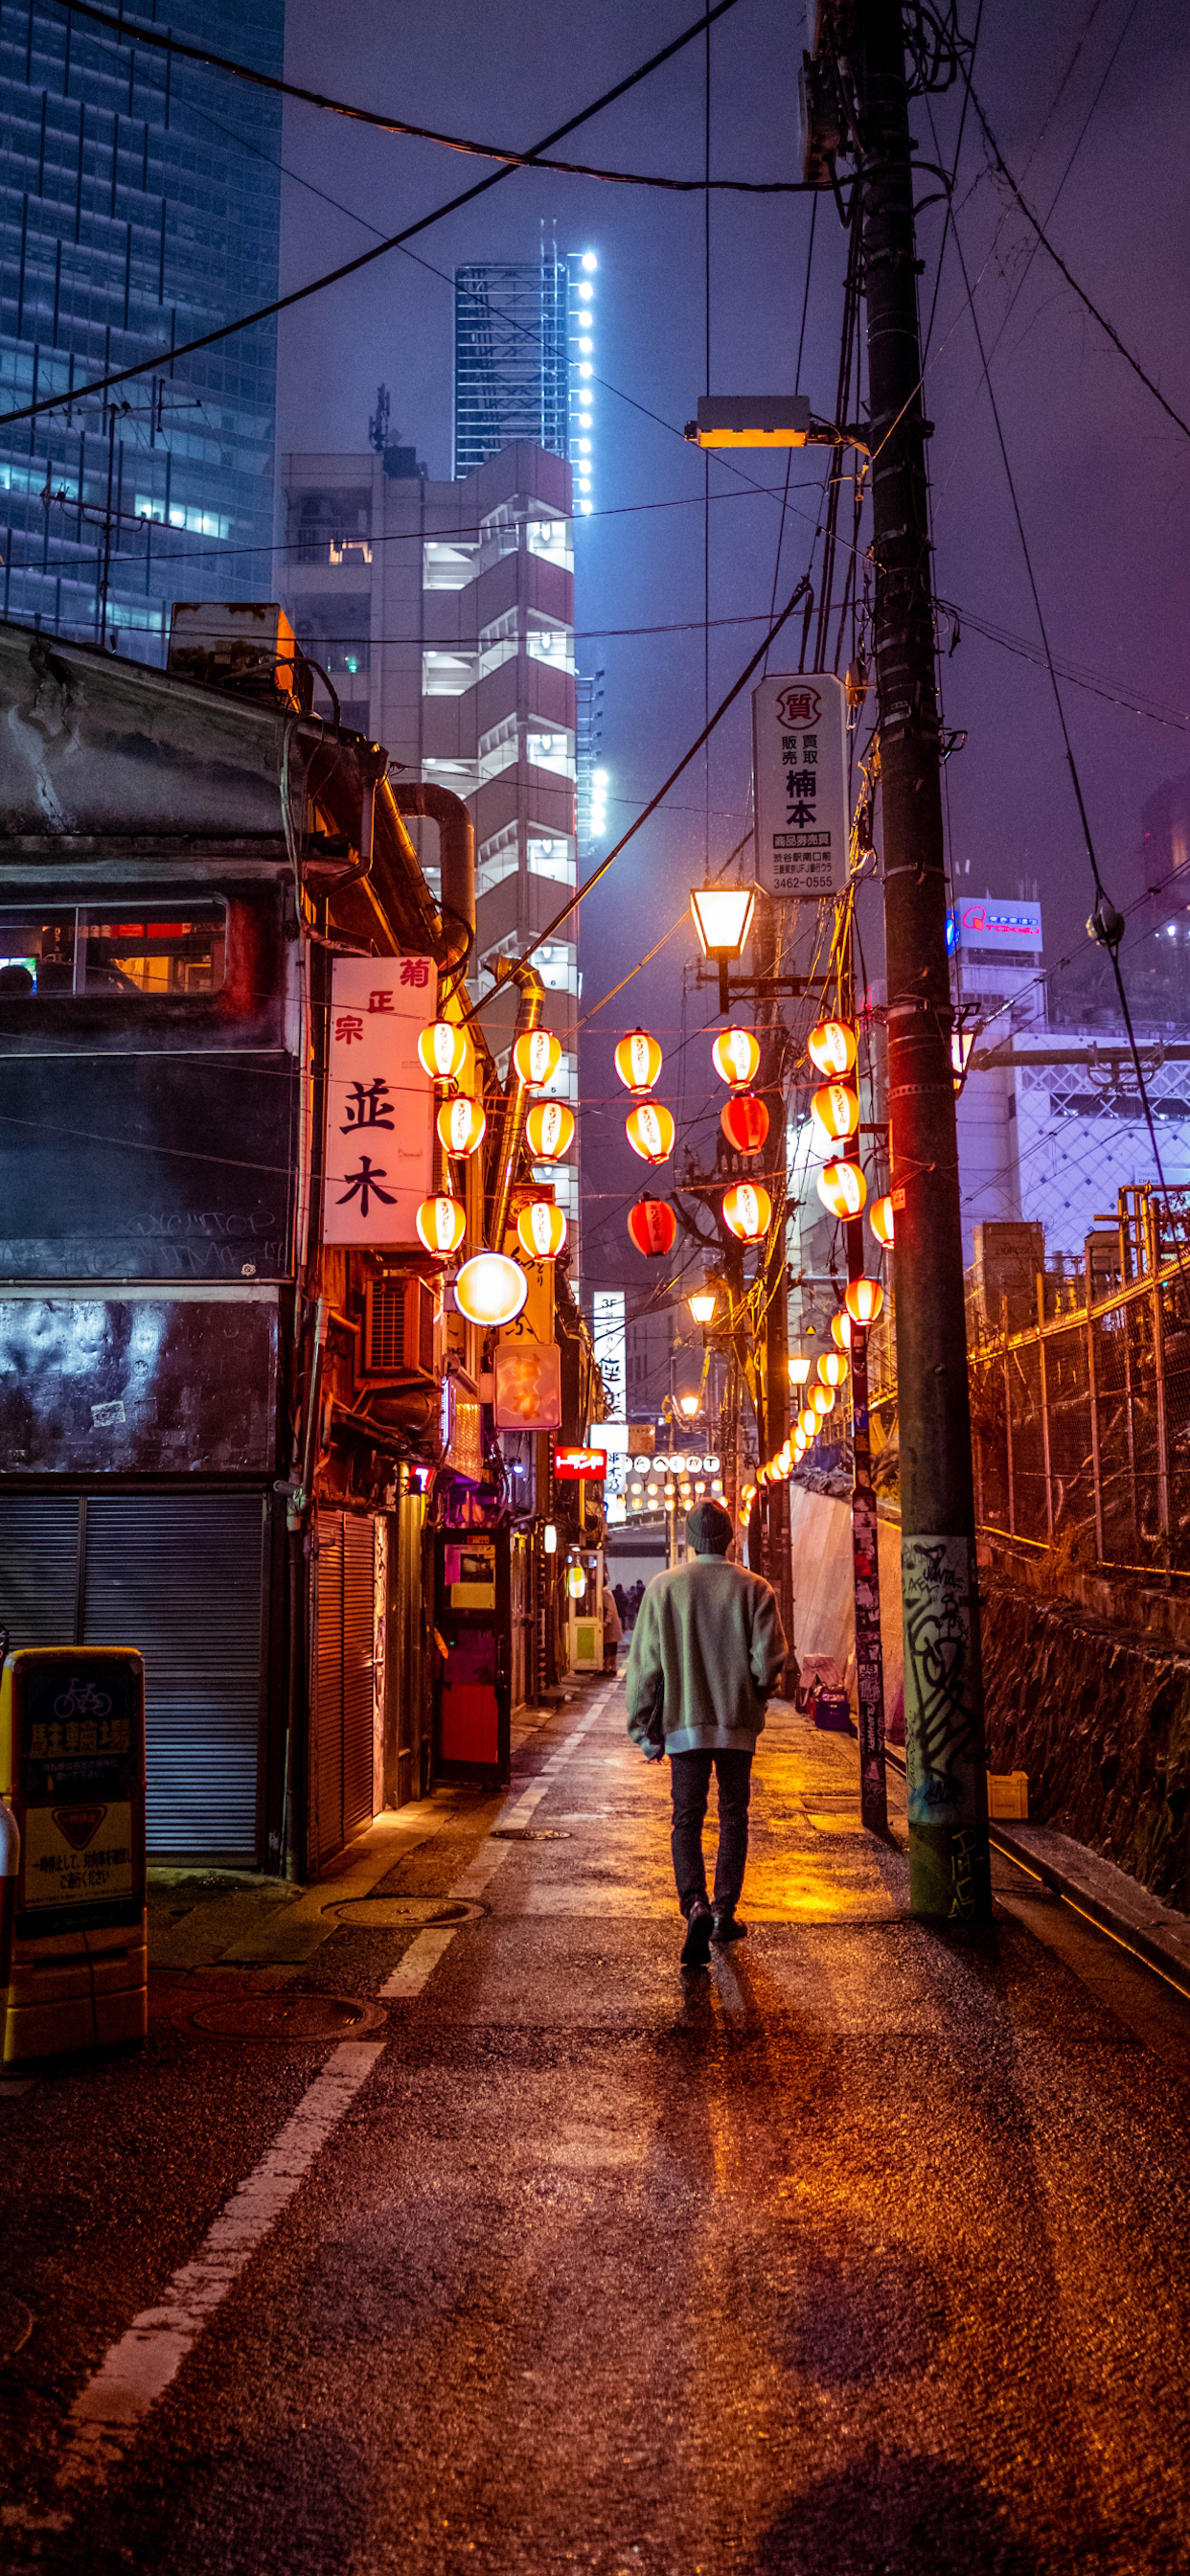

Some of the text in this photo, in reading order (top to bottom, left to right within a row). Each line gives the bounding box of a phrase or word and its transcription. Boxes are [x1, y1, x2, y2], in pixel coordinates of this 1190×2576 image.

[787, 694, 812, 721] 質
[786, 769, 816, 829] 楠本
[774, 833, 830, 847] 商品券売買
[773, 851, 832, 862] 渋谷駅南口前
[773, 876, 833, 889] 3462-0555
[335, 1078, 398, 1218] 並木
[601, 1298, 618, 1308] 3F
[33, 1719, 130, 1752] 駐輪場
[60, 1871, 110, 1889] ご通行ください
